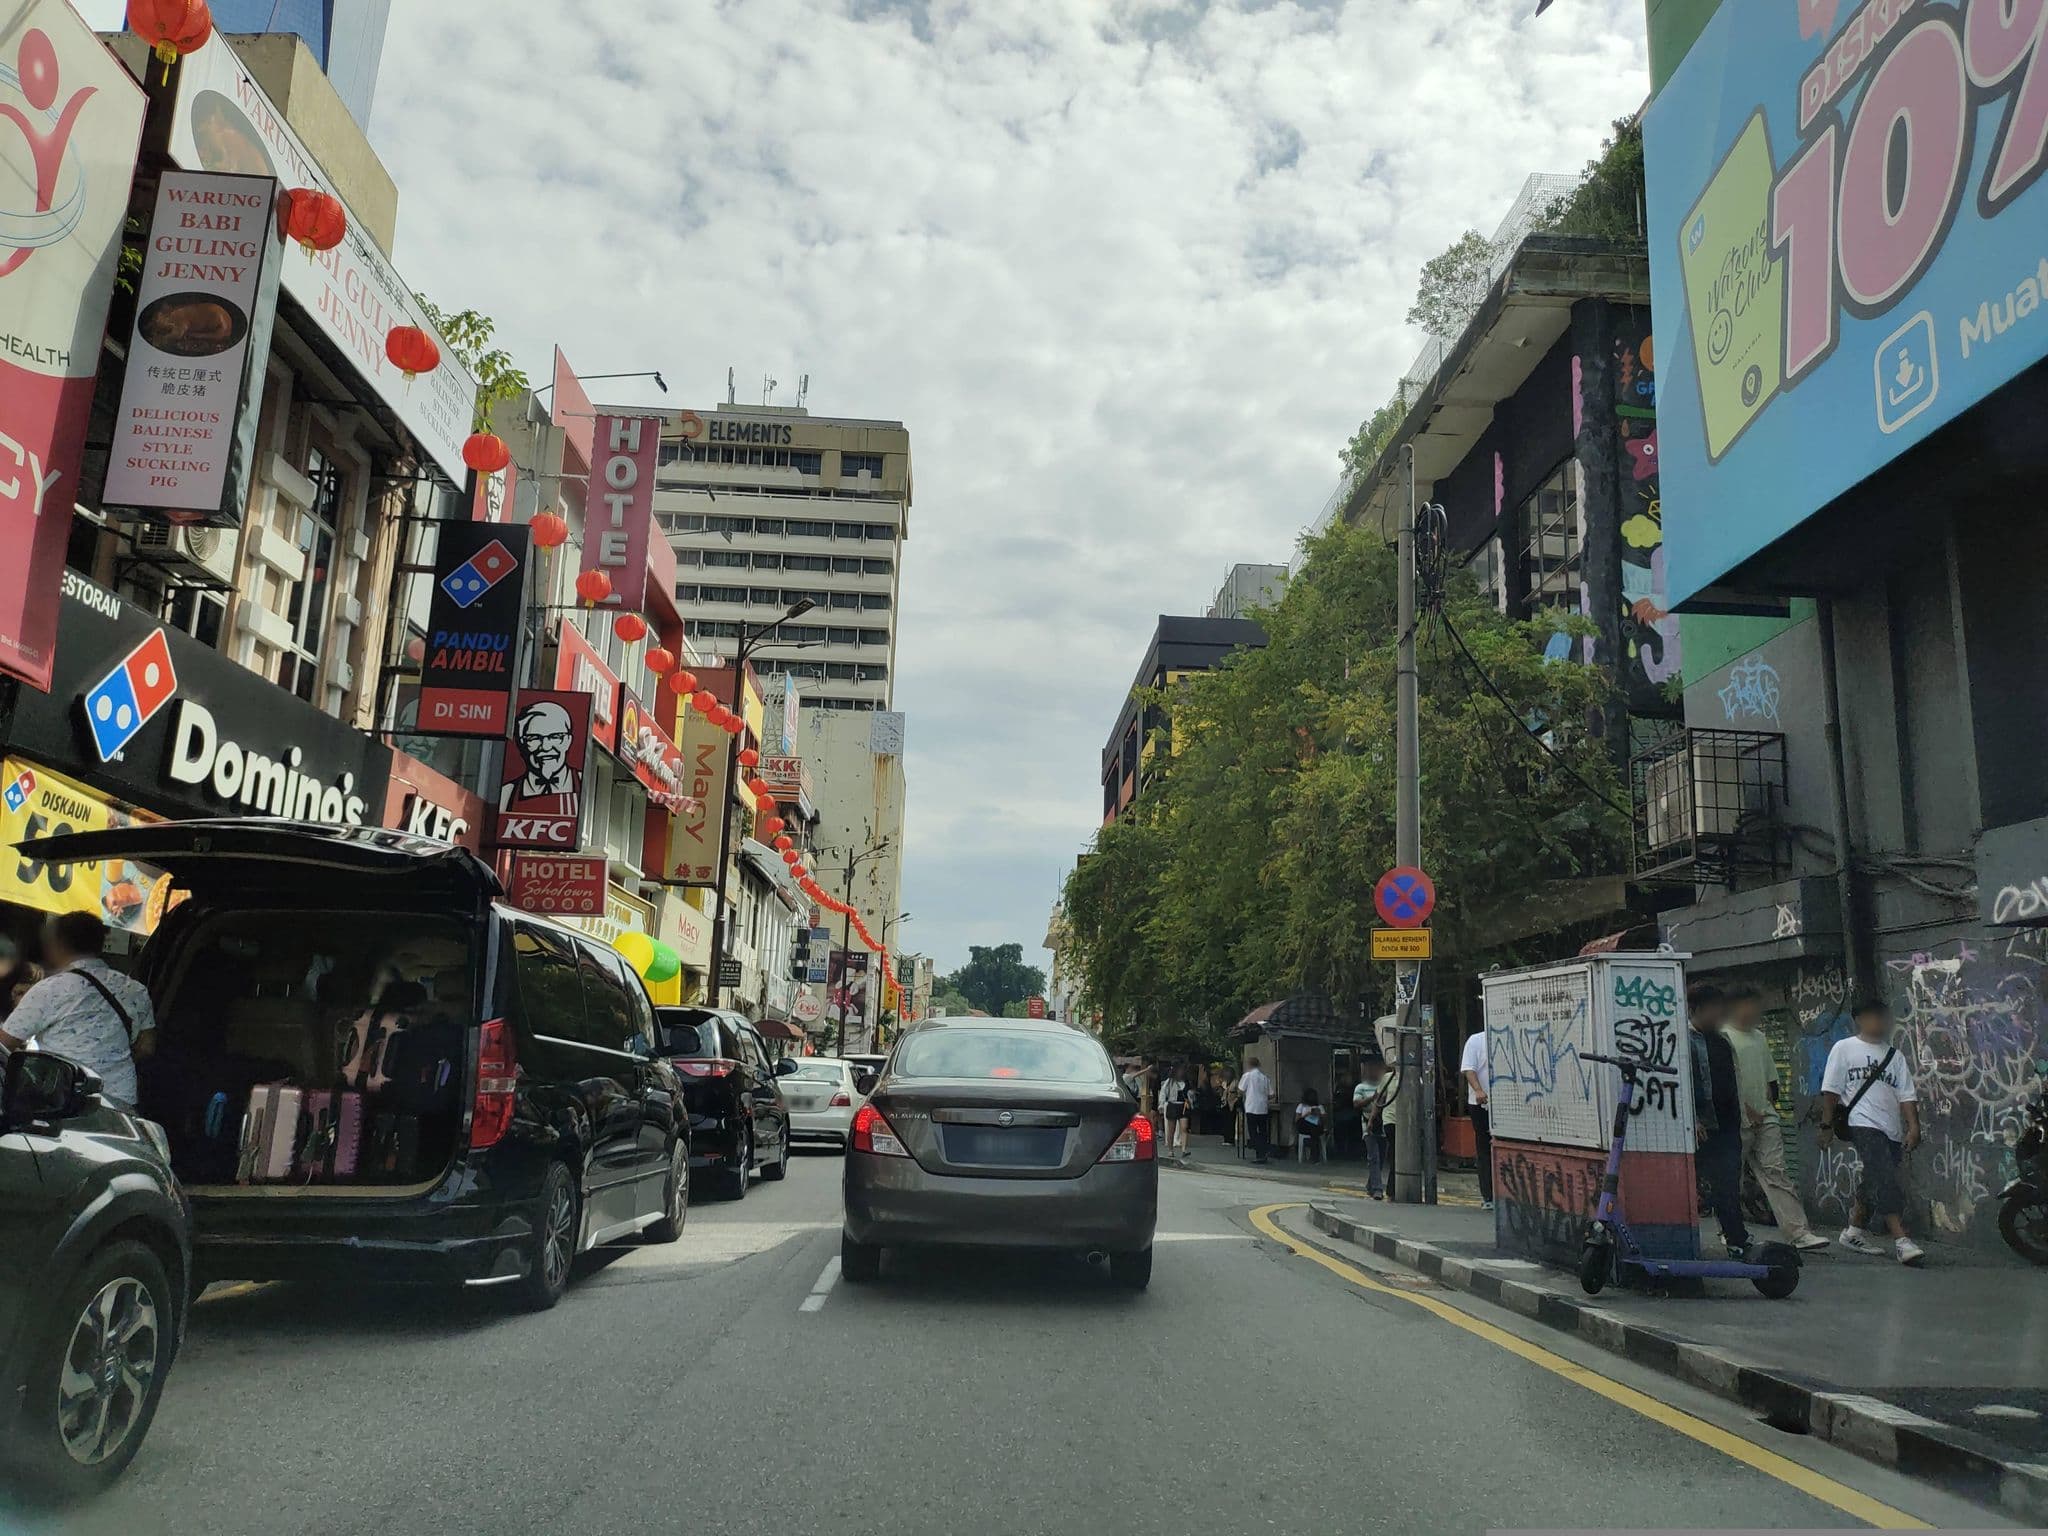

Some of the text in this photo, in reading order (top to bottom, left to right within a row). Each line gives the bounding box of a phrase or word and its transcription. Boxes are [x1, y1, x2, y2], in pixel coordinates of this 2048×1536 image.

[1801, 0, 1915, 130] DISKA
[235, 71, 310, 186] WARUNG
[168, 188, 262, 208] WARUNG
[180, 212, 242, 231] BABI
[155, 236, 257, 258] GULING
[158, 262, 247, 283] JENNY
[1735, 251, 1771, 317] Club
[318, 281, 387, 376] JENNY
[0, 333, 71, 368] HEALTH
[147, 366, 222, 382] 传统巴厘式
[161, 383, 207, 397] 脆皮猪
[431, 375, 459, 418] BALINESE
[132, 407, 219, 423] DELICIOUS
[420, 402, 451, 449] SUCKLING
[434, 400, 452, 429] STYLE
[132, 424, 213, 439] BALINESE
[709, 419, 792, 445] ELEMENTS
[142, 442, 193, 455] STYLE
[126, 457, 210, 472] SUCKLING
[150, 476, 178, 487] PIG
[433, 630, 511, 651] PANDU
[431, 648, 505, 672] AMBIL
[435, 702, 492, 720] DI SINI
[170, 699, 364, 826] Domino's
[41, 790, 91, 823] DISKAUN
[408, 796, 469, 845] KFC
[502, 818, 571, 842] KFC
[521, 862, 597, 881] HOTEL
[678, 912, 700, 943] Macy
[1848, 1066, 1898, 1088] ETENAL
